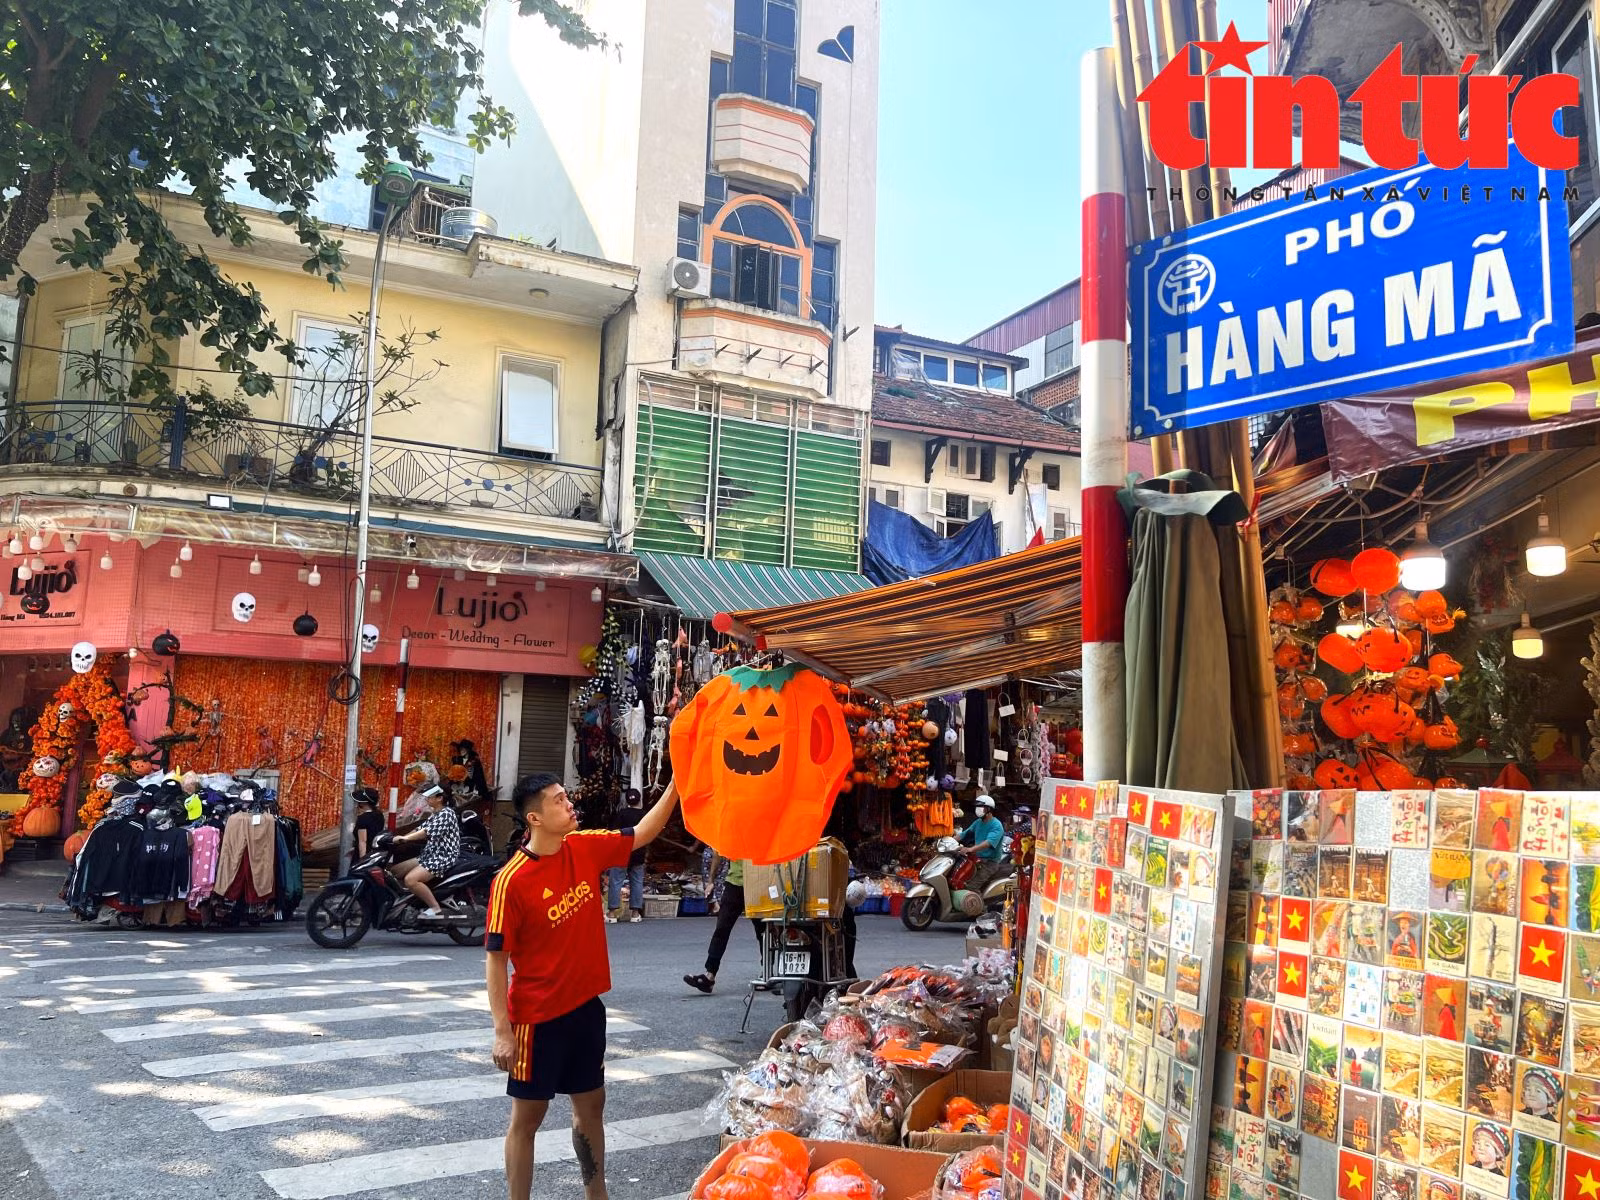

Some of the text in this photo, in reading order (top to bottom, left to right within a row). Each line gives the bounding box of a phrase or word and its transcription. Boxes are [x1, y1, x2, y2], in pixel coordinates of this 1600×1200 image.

[1284, 177, 1421, 267] PHỐ
[1166, 230, 1523, 396] HÀNG MÃ
[437, 586, 528, 629] Lujio
[401, 625, 437, 639] Decor
[448, 629, 500, 648] Wedding
[513, 633, 555, 648] Flower
[547, 880, 591, 921] adidas
